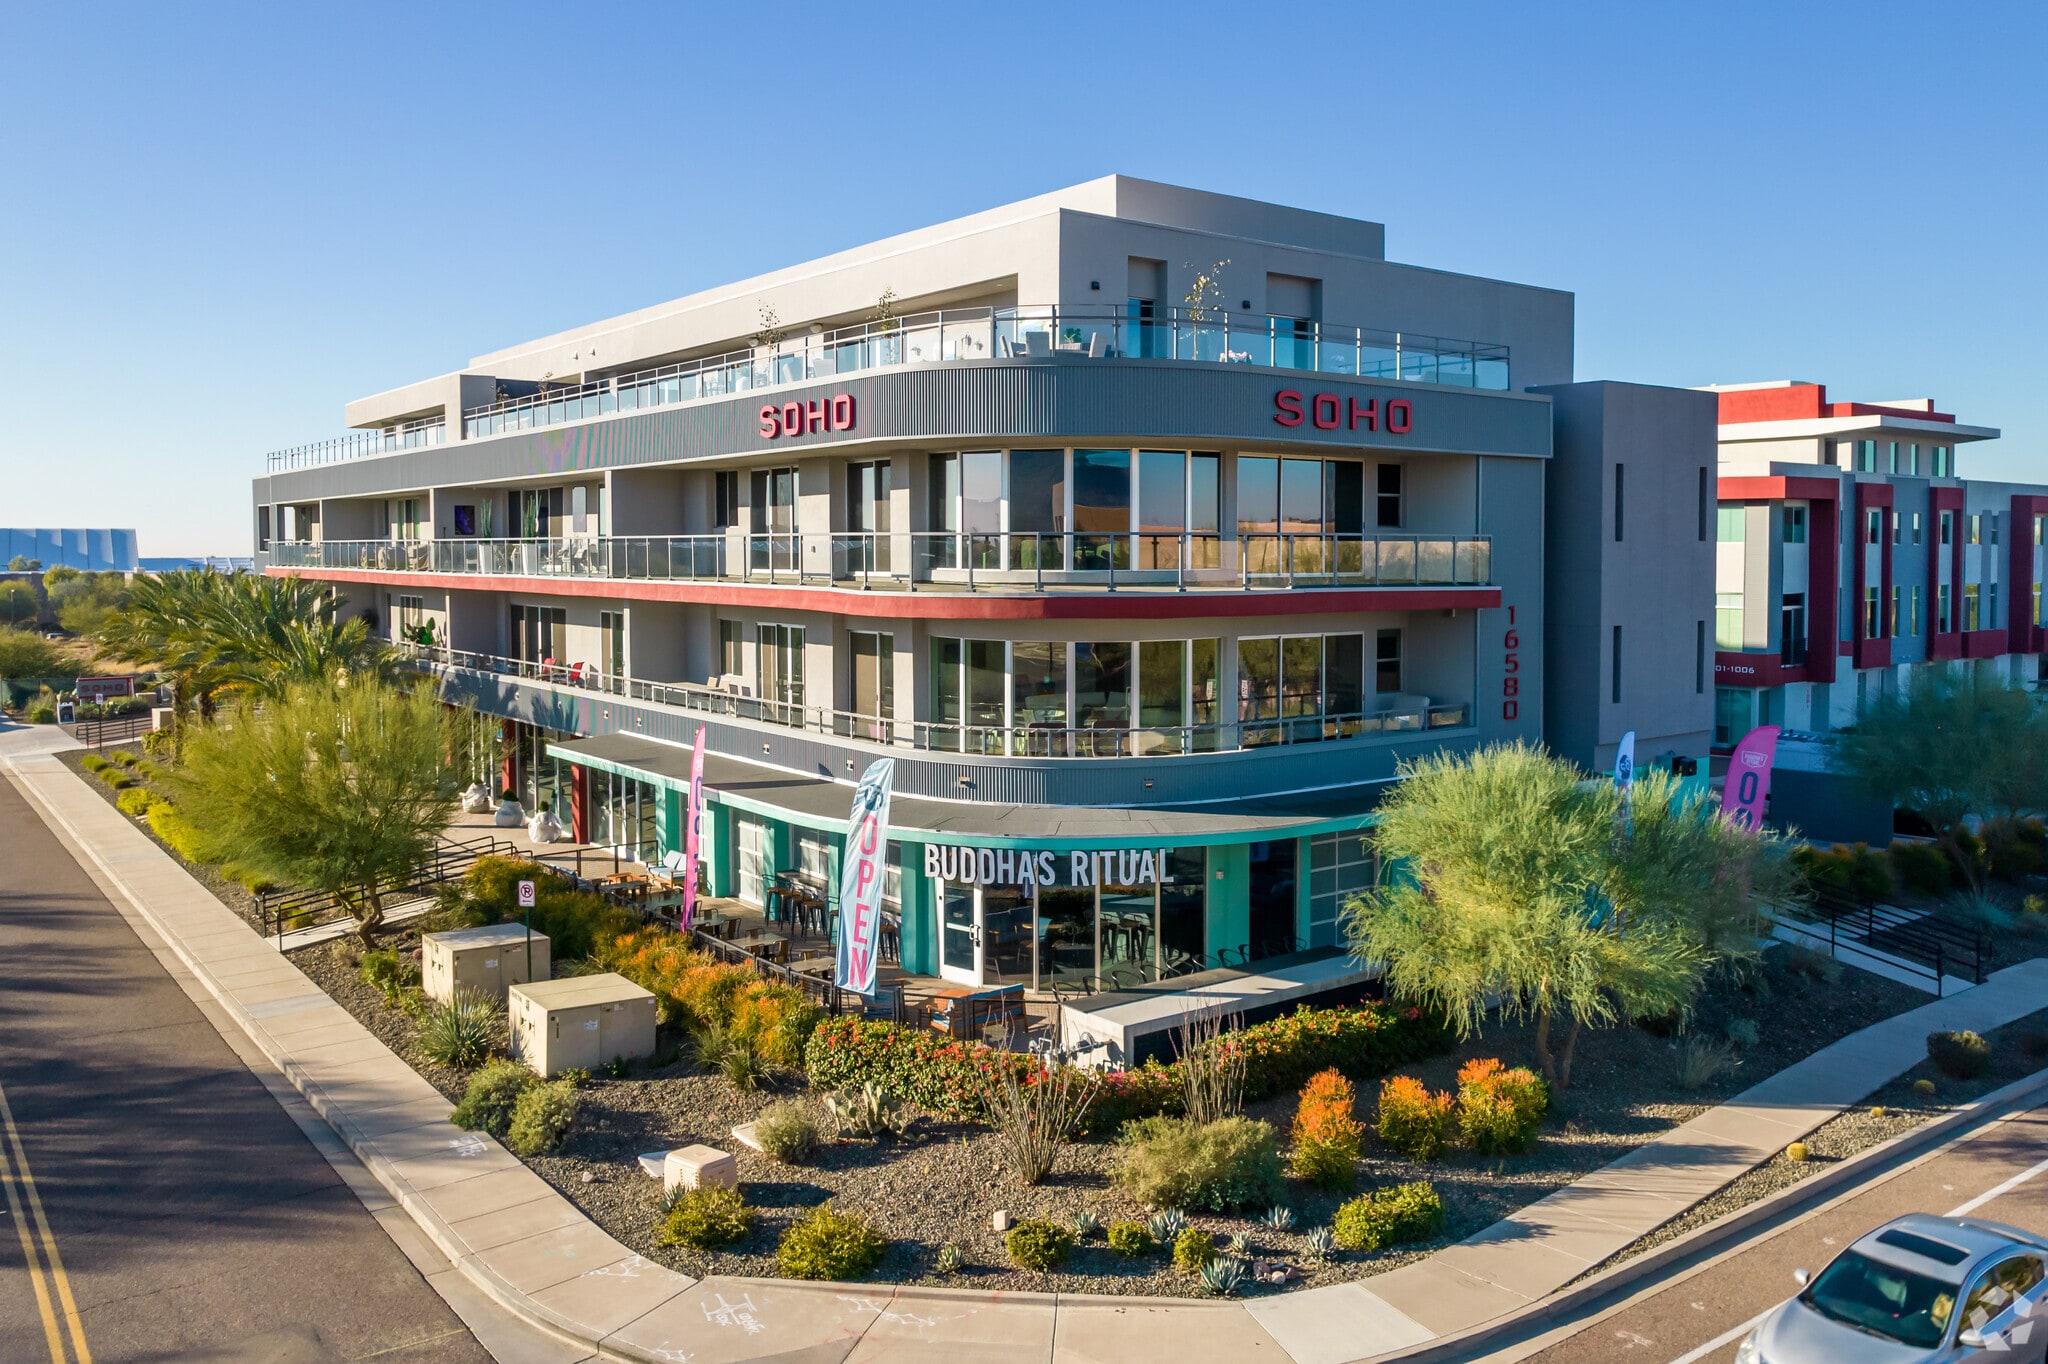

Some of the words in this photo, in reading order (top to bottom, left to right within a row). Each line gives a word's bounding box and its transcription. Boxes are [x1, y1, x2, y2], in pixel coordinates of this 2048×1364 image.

[759, 394, 856, 438] SOHO
[1273, 389, 1412, 434] SOHO
[1503, 605, 1519, 720] 16580
[81, 683, 123, 692] SOHO
[1071, 849, 1174, 887] RITUAL
[849, 813, 878, 989] OPEN
